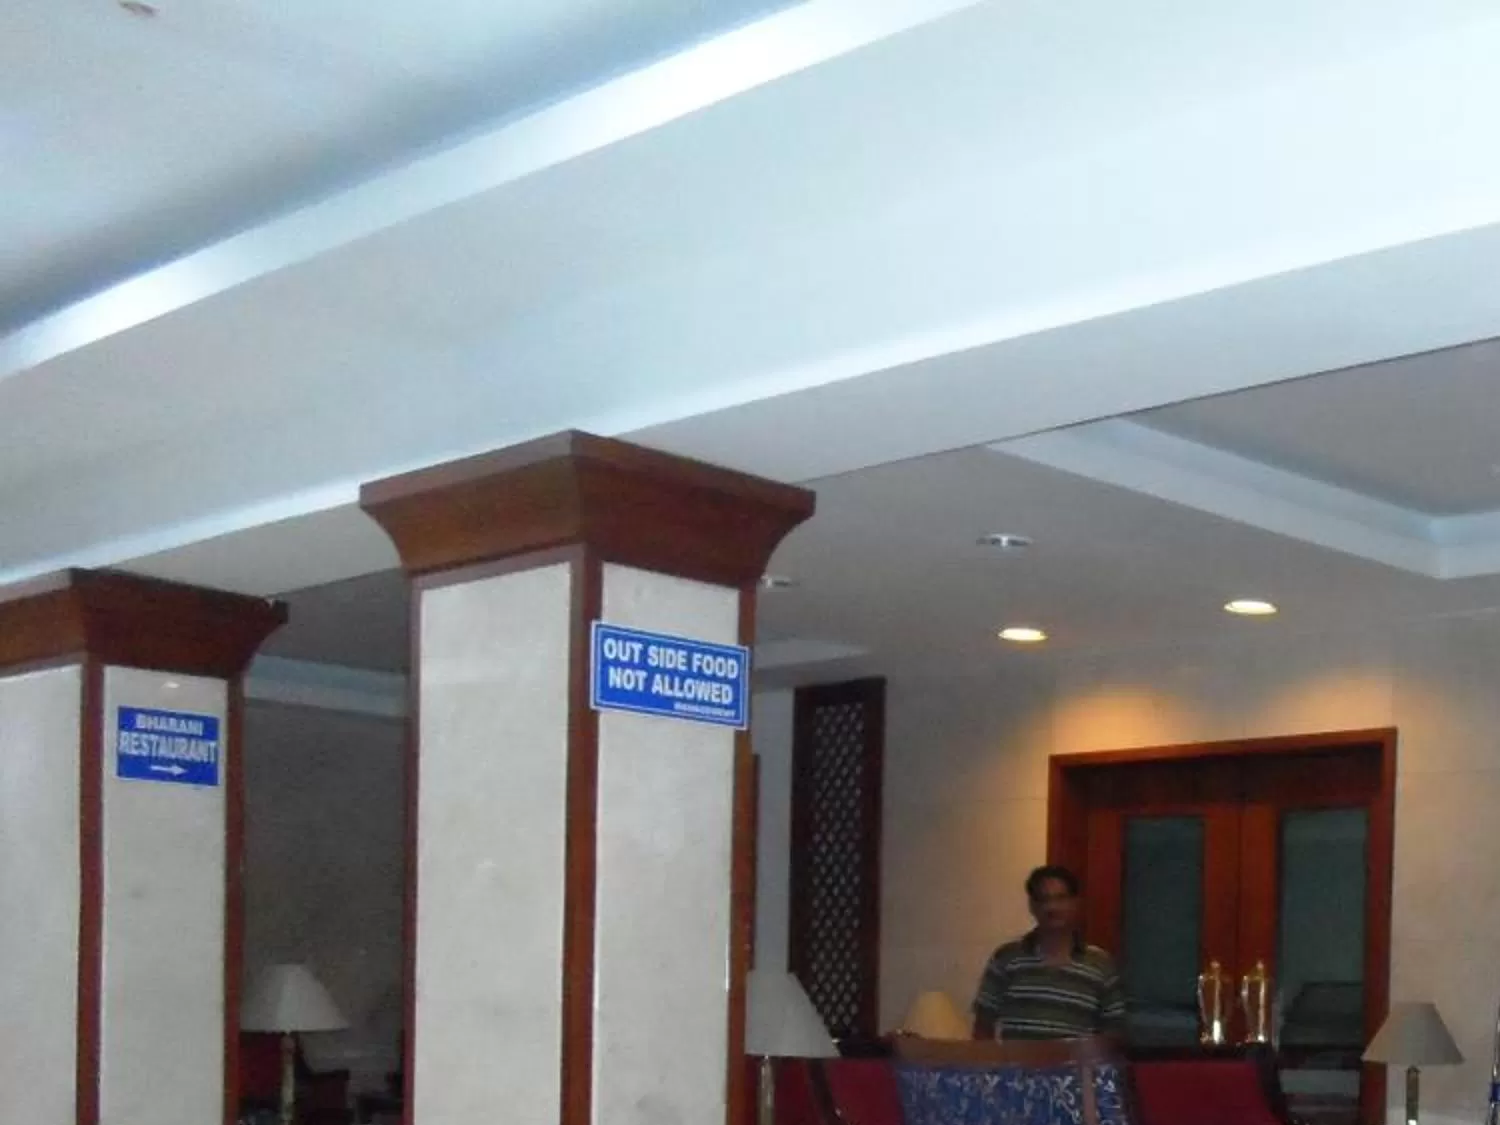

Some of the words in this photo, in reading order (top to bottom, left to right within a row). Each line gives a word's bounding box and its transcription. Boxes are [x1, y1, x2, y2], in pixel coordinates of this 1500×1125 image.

[603, 638, 643, 664] OUT
[647, 645, 688, 671] SIDE
[692, 652, 739, 679] FOOD
[608, 666, 648, 692] NOT
[651, 673, 733, 705] ALLOWED
